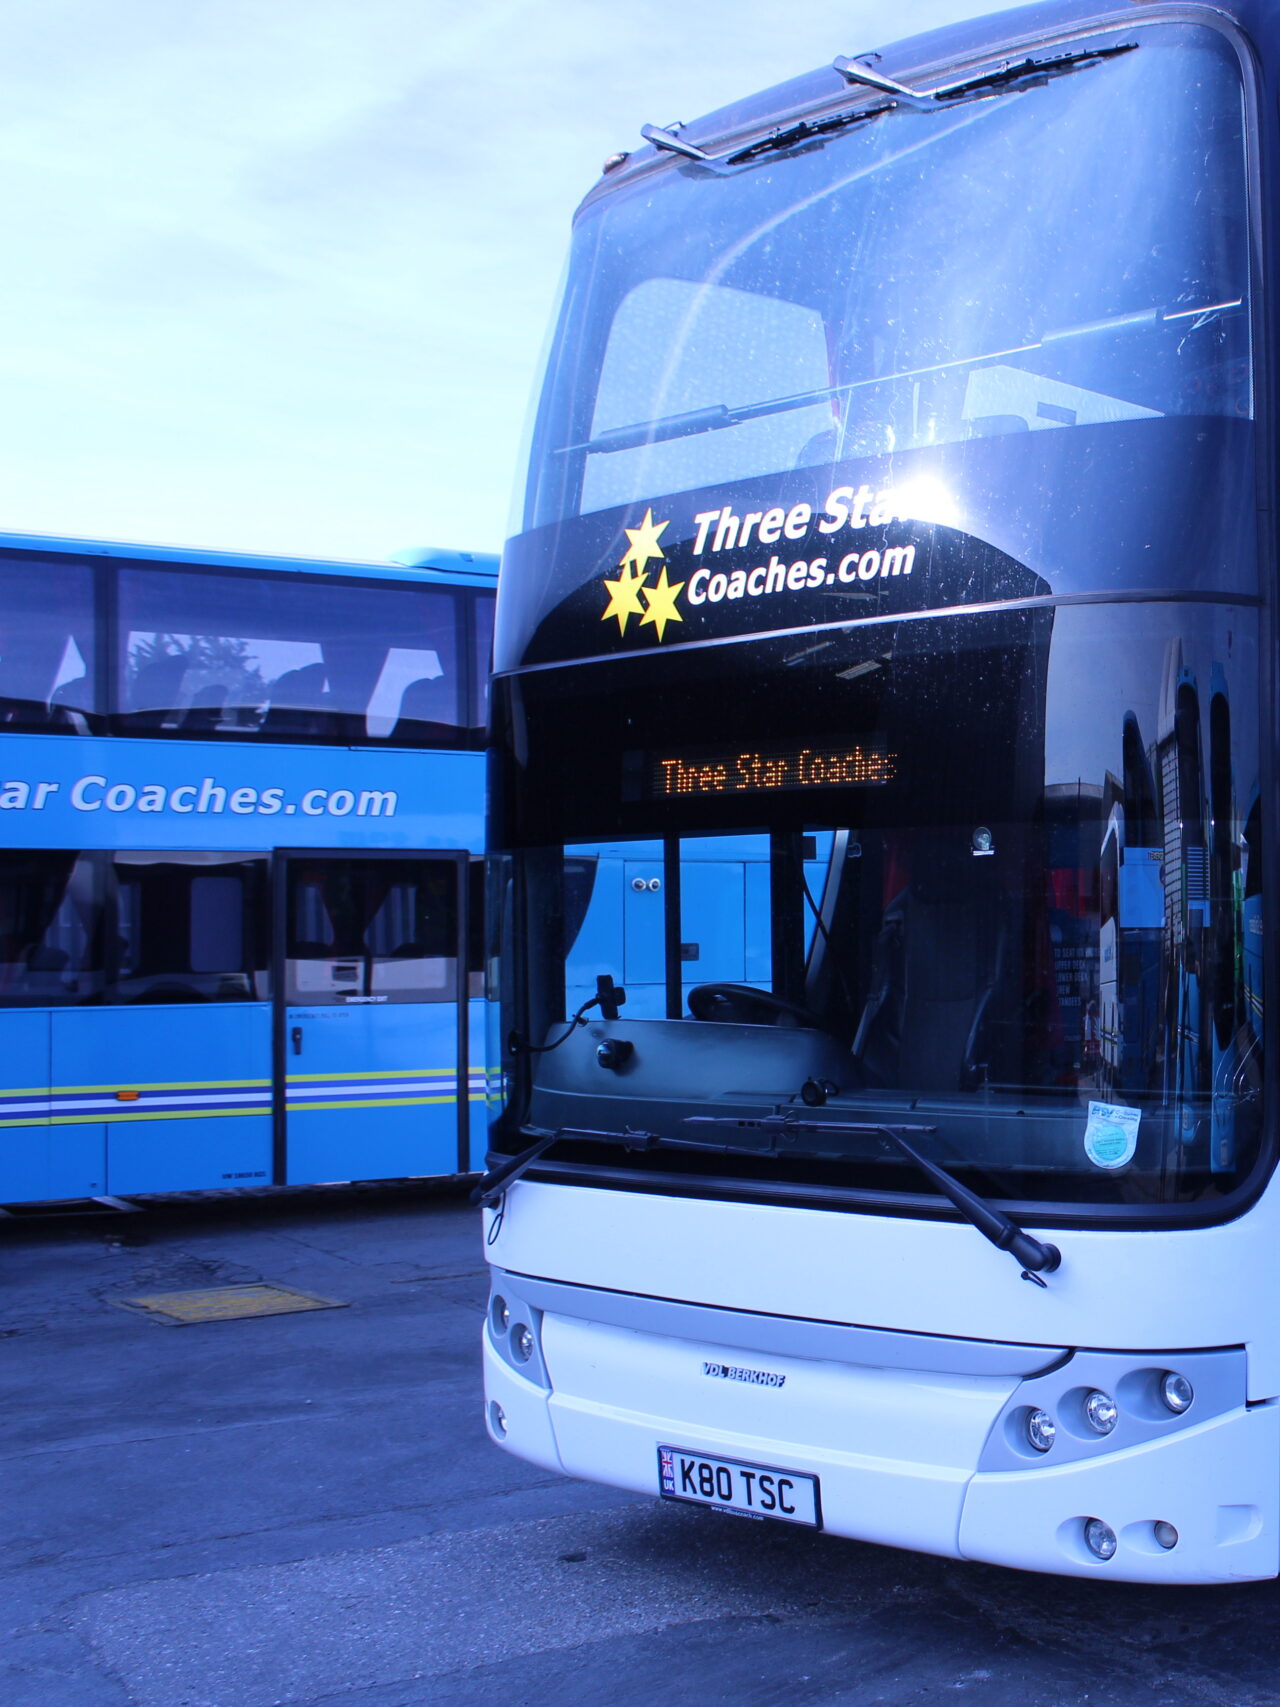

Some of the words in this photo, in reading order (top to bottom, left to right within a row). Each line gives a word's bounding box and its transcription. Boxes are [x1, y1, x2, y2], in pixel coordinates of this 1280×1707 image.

[692, 503, 811, 555] Three
[819, 484, 920, 534] Sta
[687, 545, 916, 605] Coaches.com
[662, 759, 726, 793] Three
[737, 753, 788, 788] Star
[799, 746, 898, 785] Coaches
[71, 774, 399, 817] Coaches.com
[703, 1362, 726, 1378] VDL
[726, 1366, 786, 1388] BERKHOF
[664, 1478, 675, 1491] UK
[680, 1458, 733, 1501] K80
[740, 1470, 796, 1514] TSC
